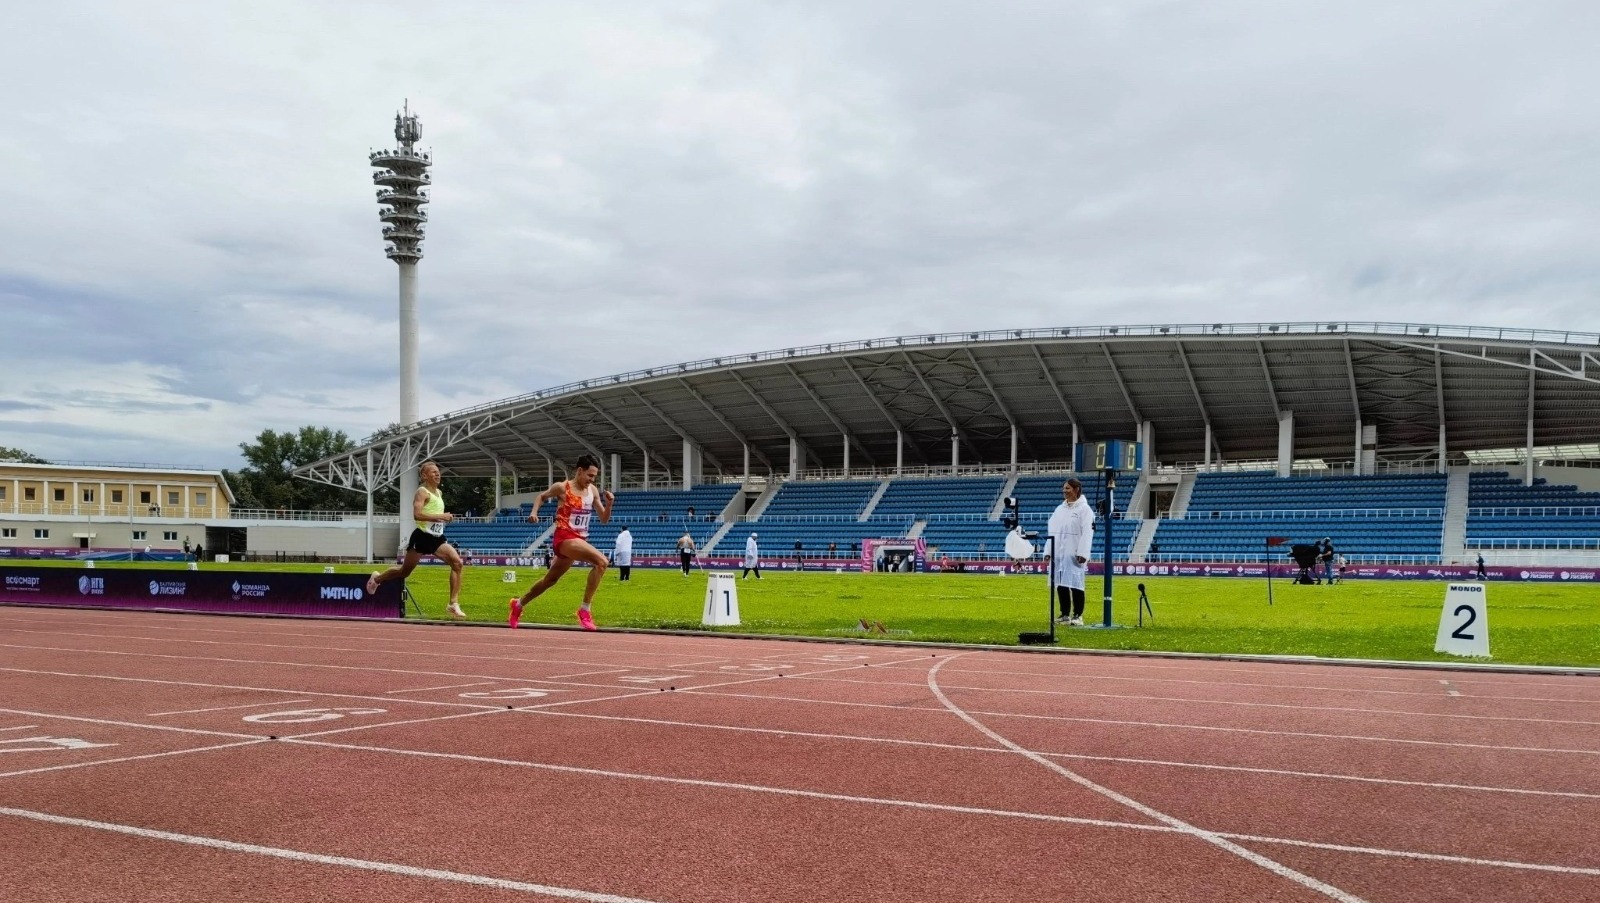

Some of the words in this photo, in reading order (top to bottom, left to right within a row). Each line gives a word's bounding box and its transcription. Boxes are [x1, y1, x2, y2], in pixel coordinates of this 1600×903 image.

[430, 523, 442, 533] 422
[574, 516, 588, 526] 611
[724, 590, 730, 616] 1
[1452, 605, 1476, 640] 2
[242, 708, 388, 723] 6
